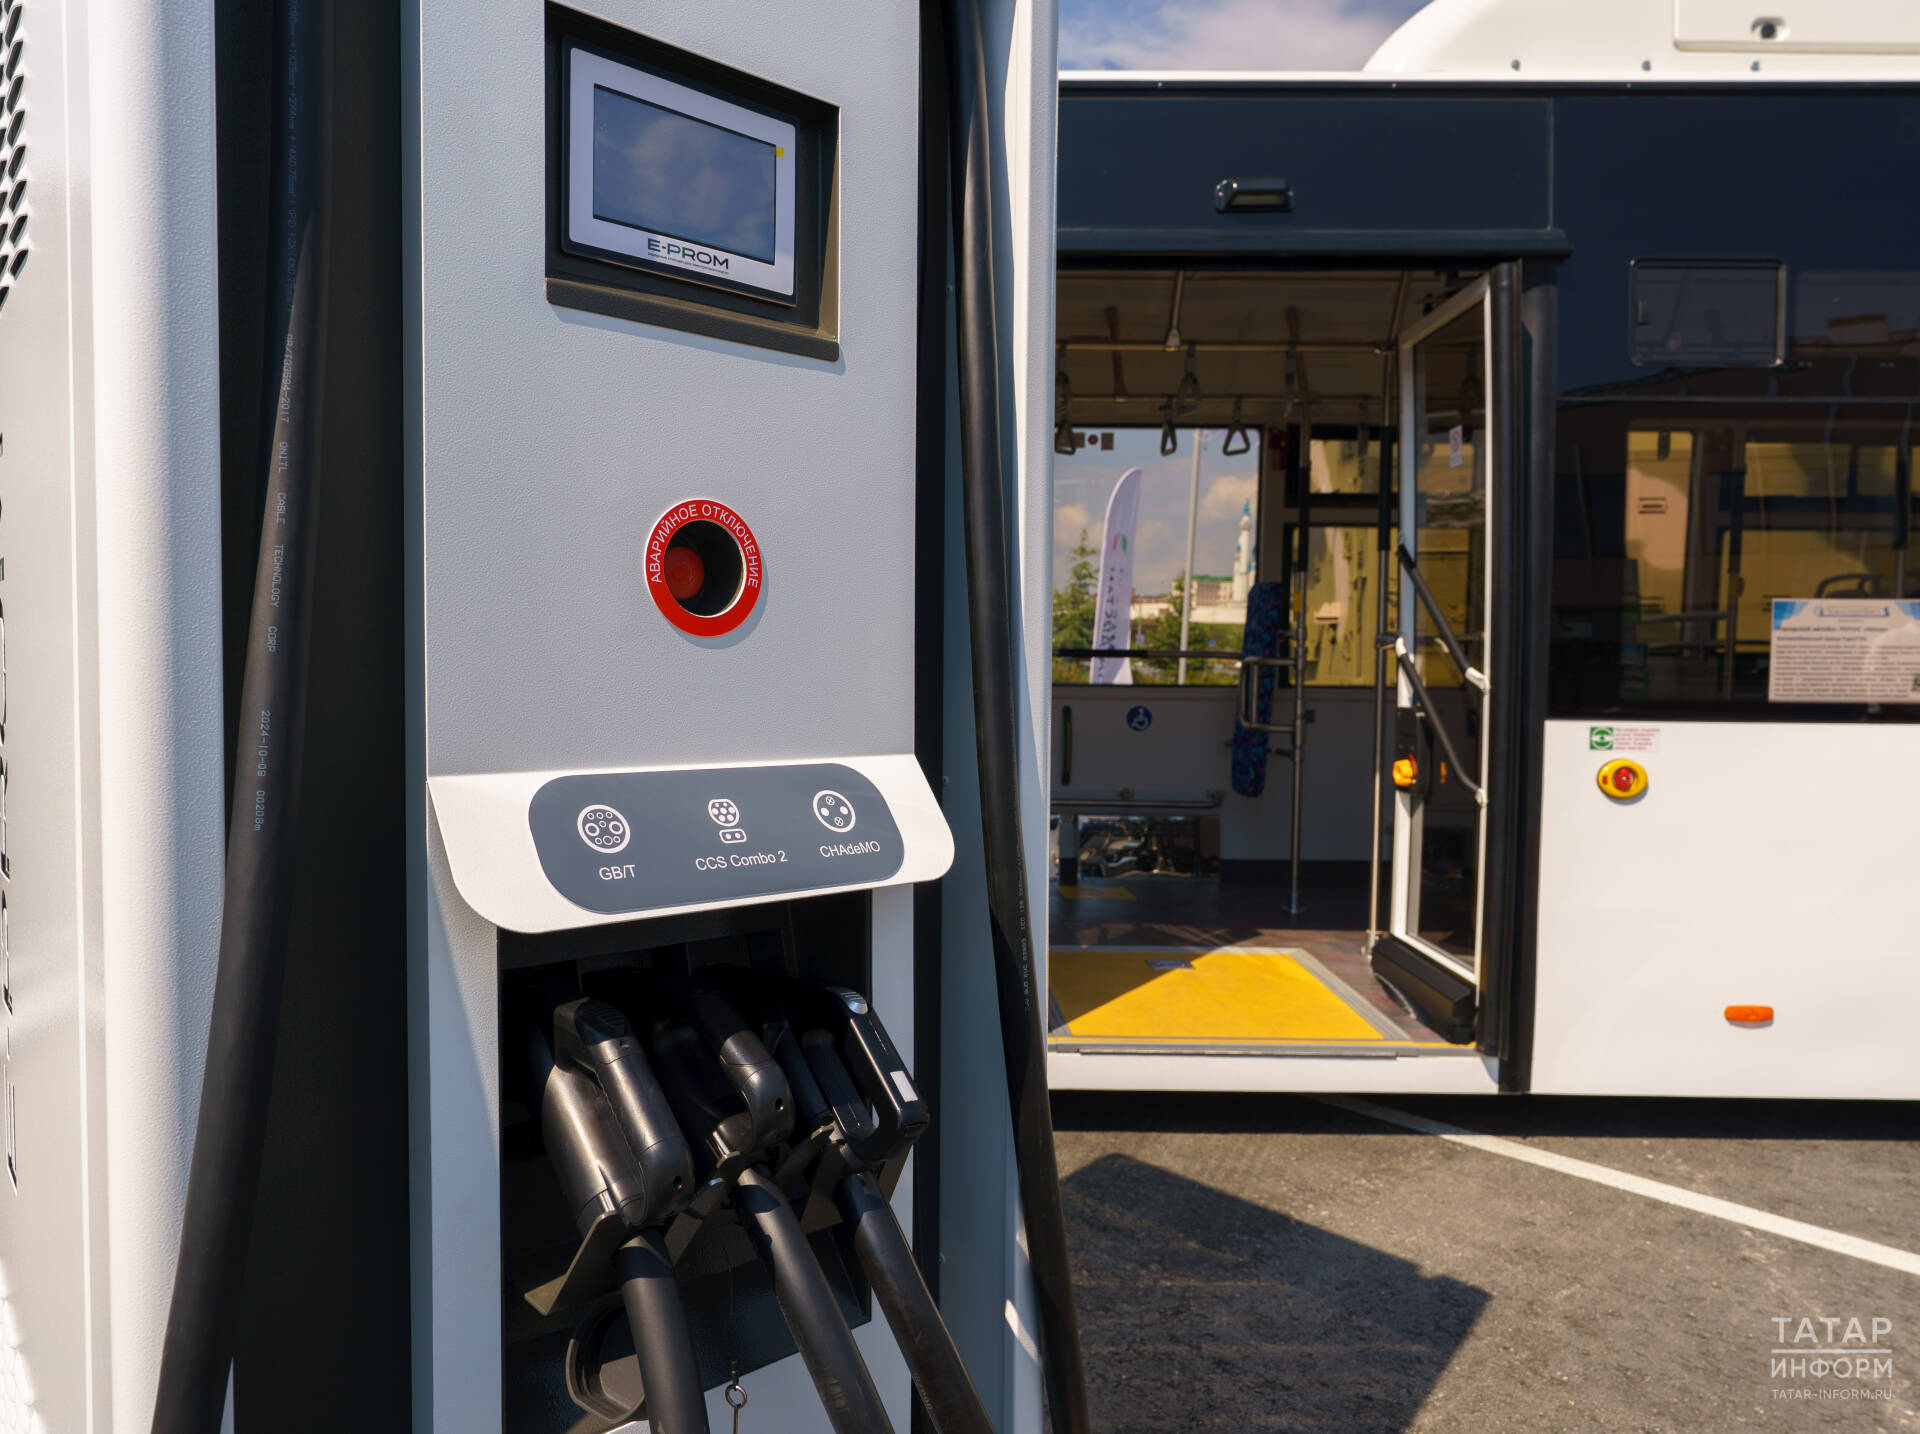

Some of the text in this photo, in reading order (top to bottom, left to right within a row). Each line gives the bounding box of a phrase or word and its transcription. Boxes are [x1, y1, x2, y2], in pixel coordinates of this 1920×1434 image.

[648, 238, 729, 270] E-PROM
[276, 492, 287, 524] CABLE
[650, 503, 759, 588] АВАРИЙНОЕ ОТКЛЮЧЕНИЕ
[270, 544, 284, 608] TECHNOLOGY
[266, 626, 278, 653] CORP
[695, 850, 788, 871] CCS Combo 2
[819, 840, 881, 858] CHAdeMO
[598, 864, 636, 881] GB/T
